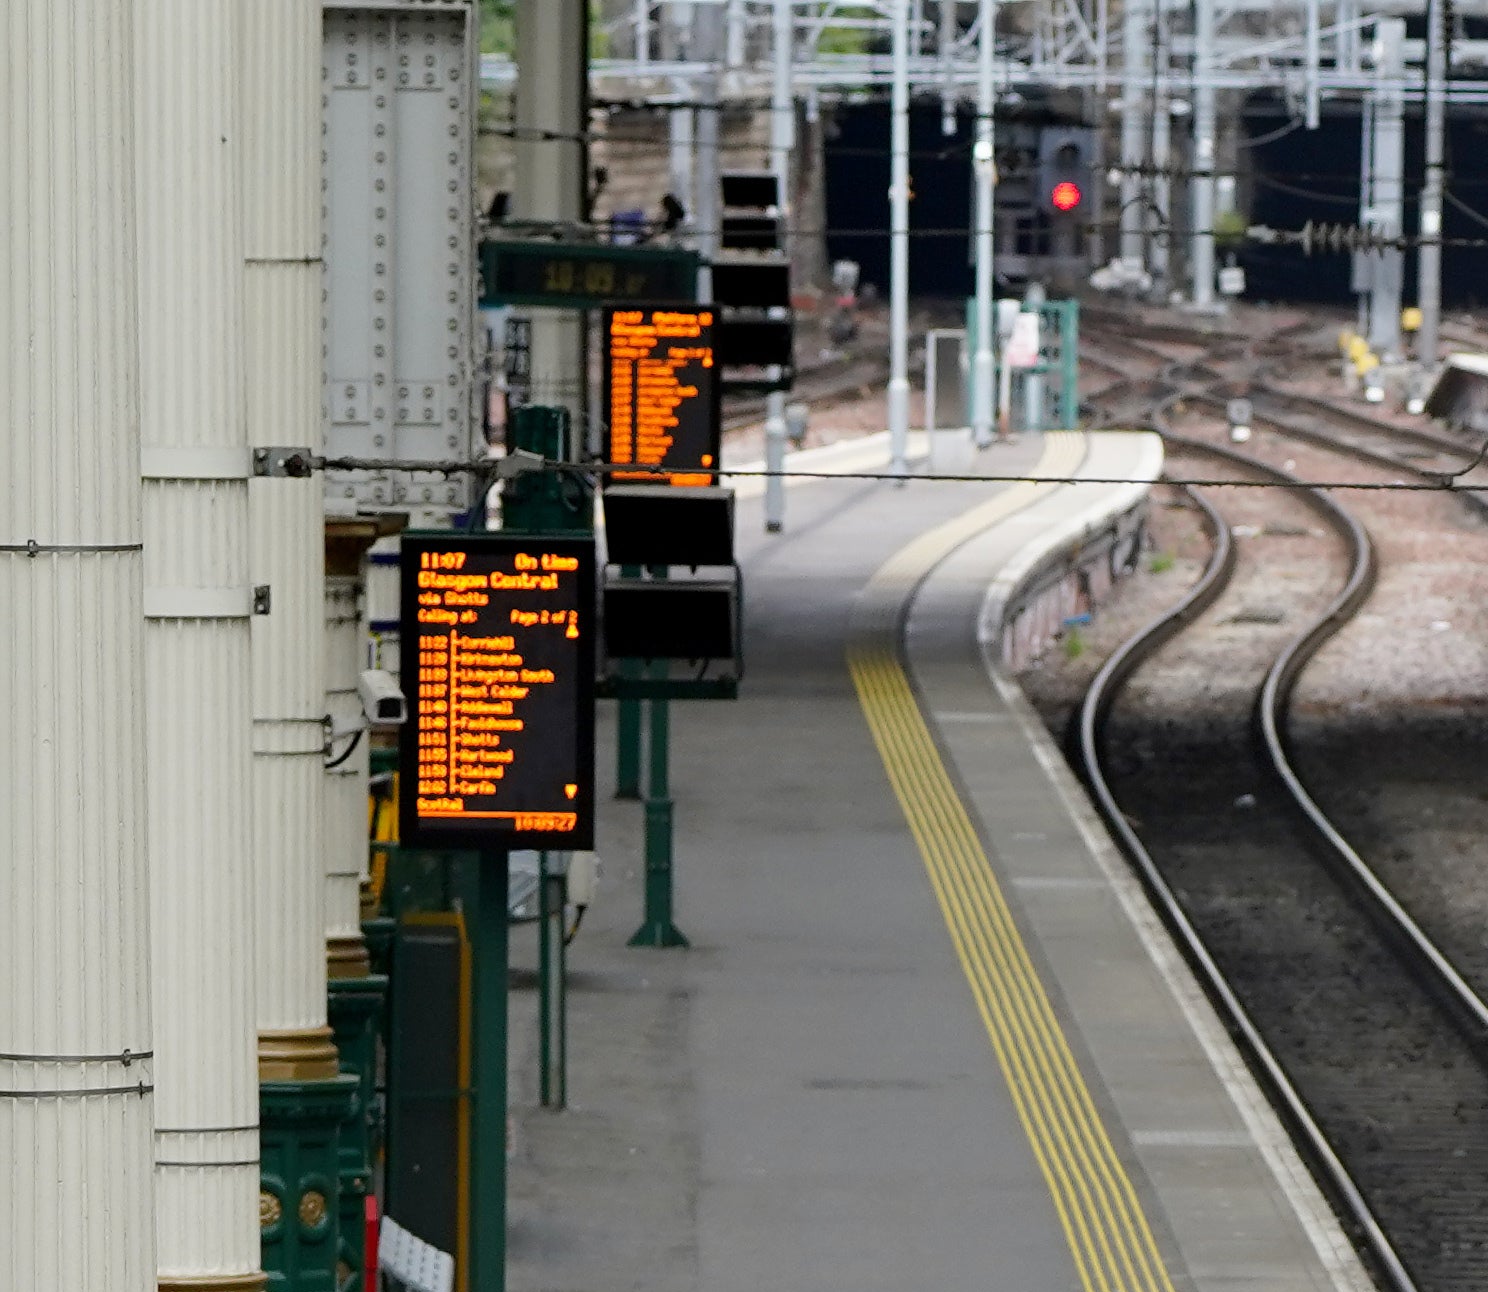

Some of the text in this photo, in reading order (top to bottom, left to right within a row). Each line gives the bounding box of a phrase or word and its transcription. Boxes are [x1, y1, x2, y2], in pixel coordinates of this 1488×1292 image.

[421, 552, 579, 570] 11:07 On time
[417, 571, 559, 591] Glasgow Central
[418, 591, 489, 606] via Shotts
[417, 608, 458, 625] Calling
[510, 609, 538, 626] Page
